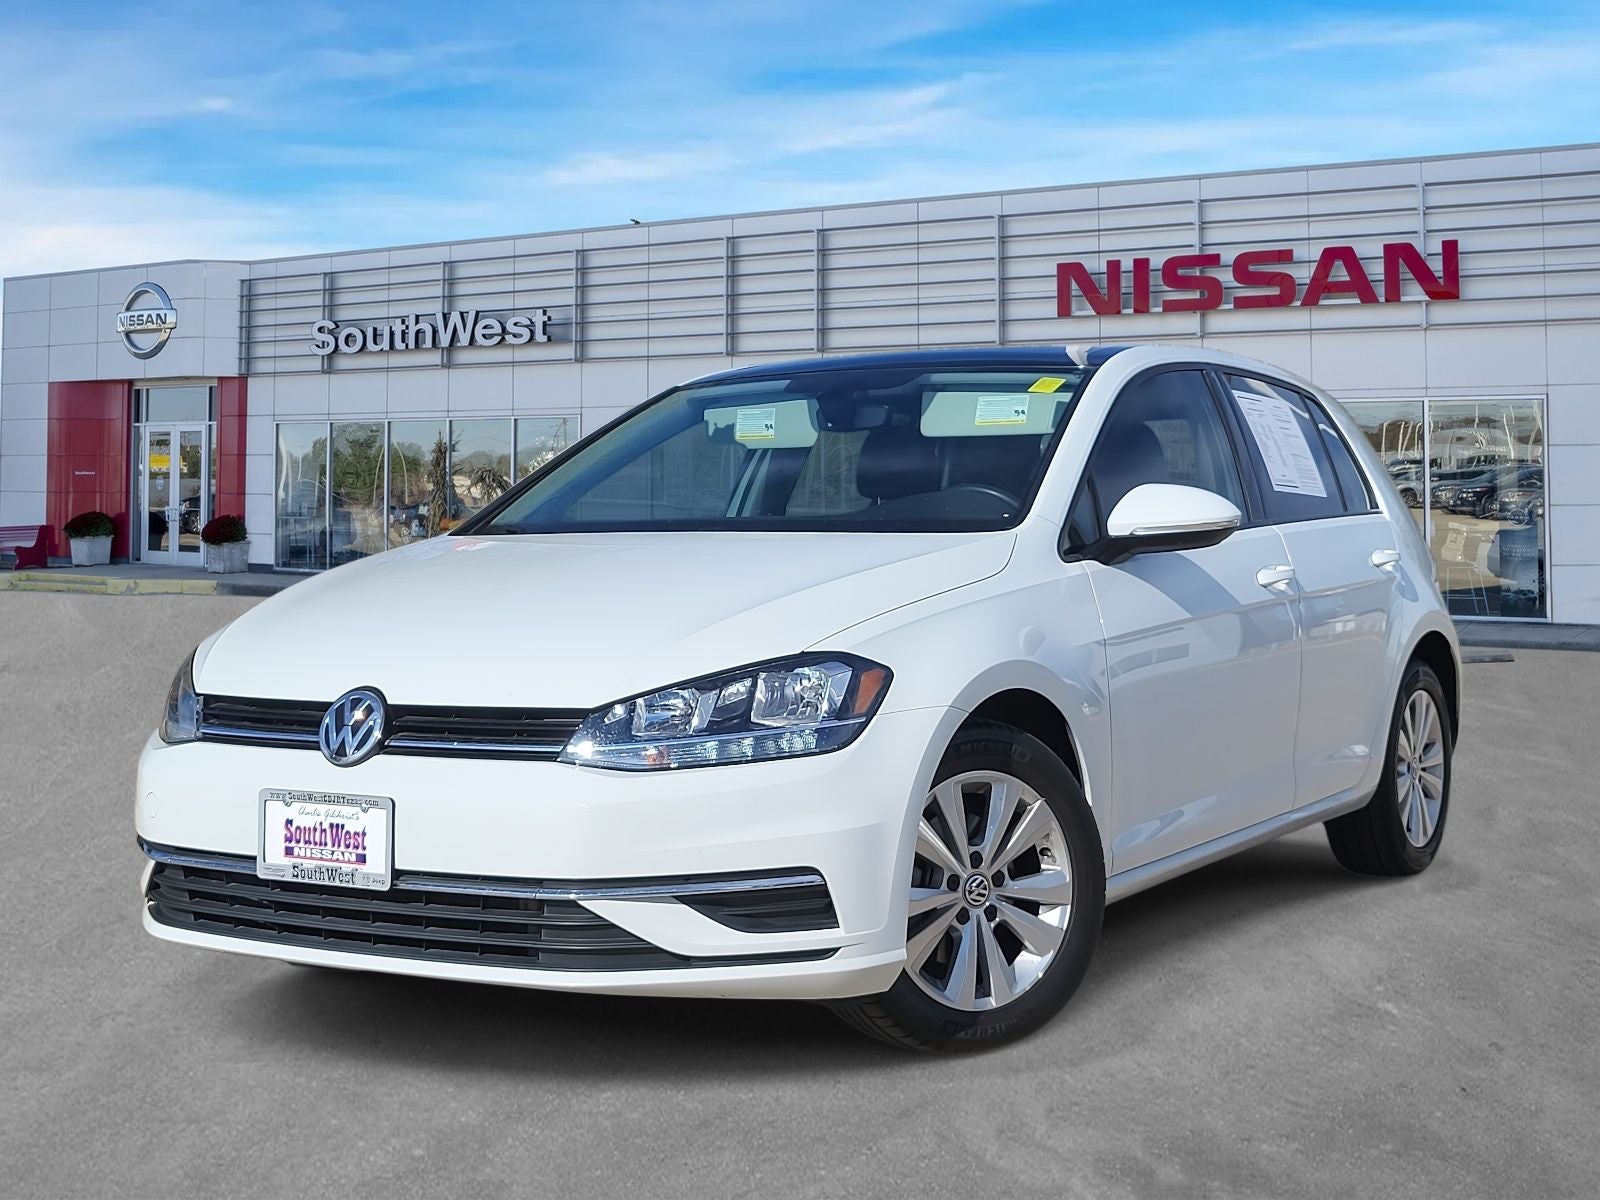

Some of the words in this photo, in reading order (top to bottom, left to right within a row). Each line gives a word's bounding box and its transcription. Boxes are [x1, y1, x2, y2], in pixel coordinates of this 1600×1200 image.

[1056, 239, 1461, 318] NISSAN
[119, 312, 168, 328] NISSAN
[309, 308, 550, 356] SouthWest
[284, 817, 367, 851] SouthWest
[293, 846, 357, 862] NISSAN
[292, 864, 356, 885] SouthWest
